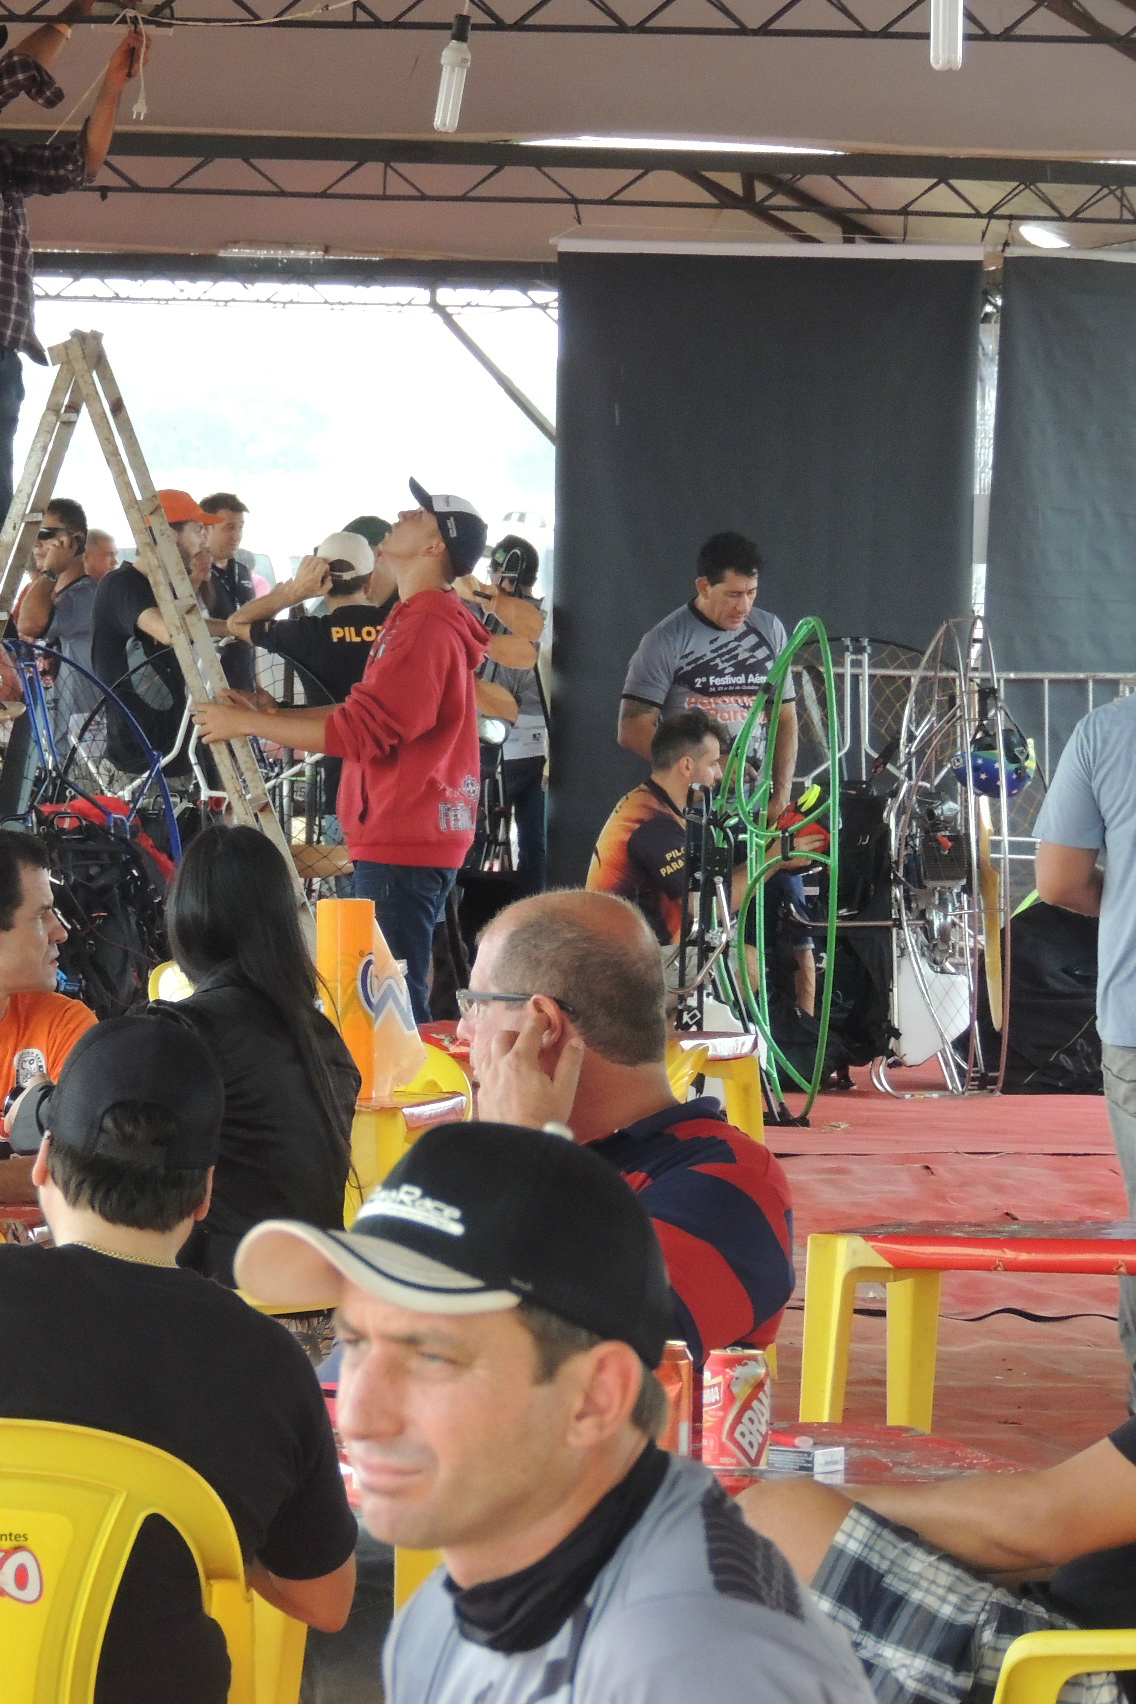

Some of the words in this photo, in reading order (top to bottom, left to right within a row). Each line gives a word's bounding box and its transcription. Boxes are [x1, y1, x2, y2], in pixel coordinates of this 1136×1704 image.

[694, 676, 707, 688] 2º
[709, 674, 745, 685] Festival
[747, 673, 768, 683] Aér
[659, 859, 685, 878] PARA
